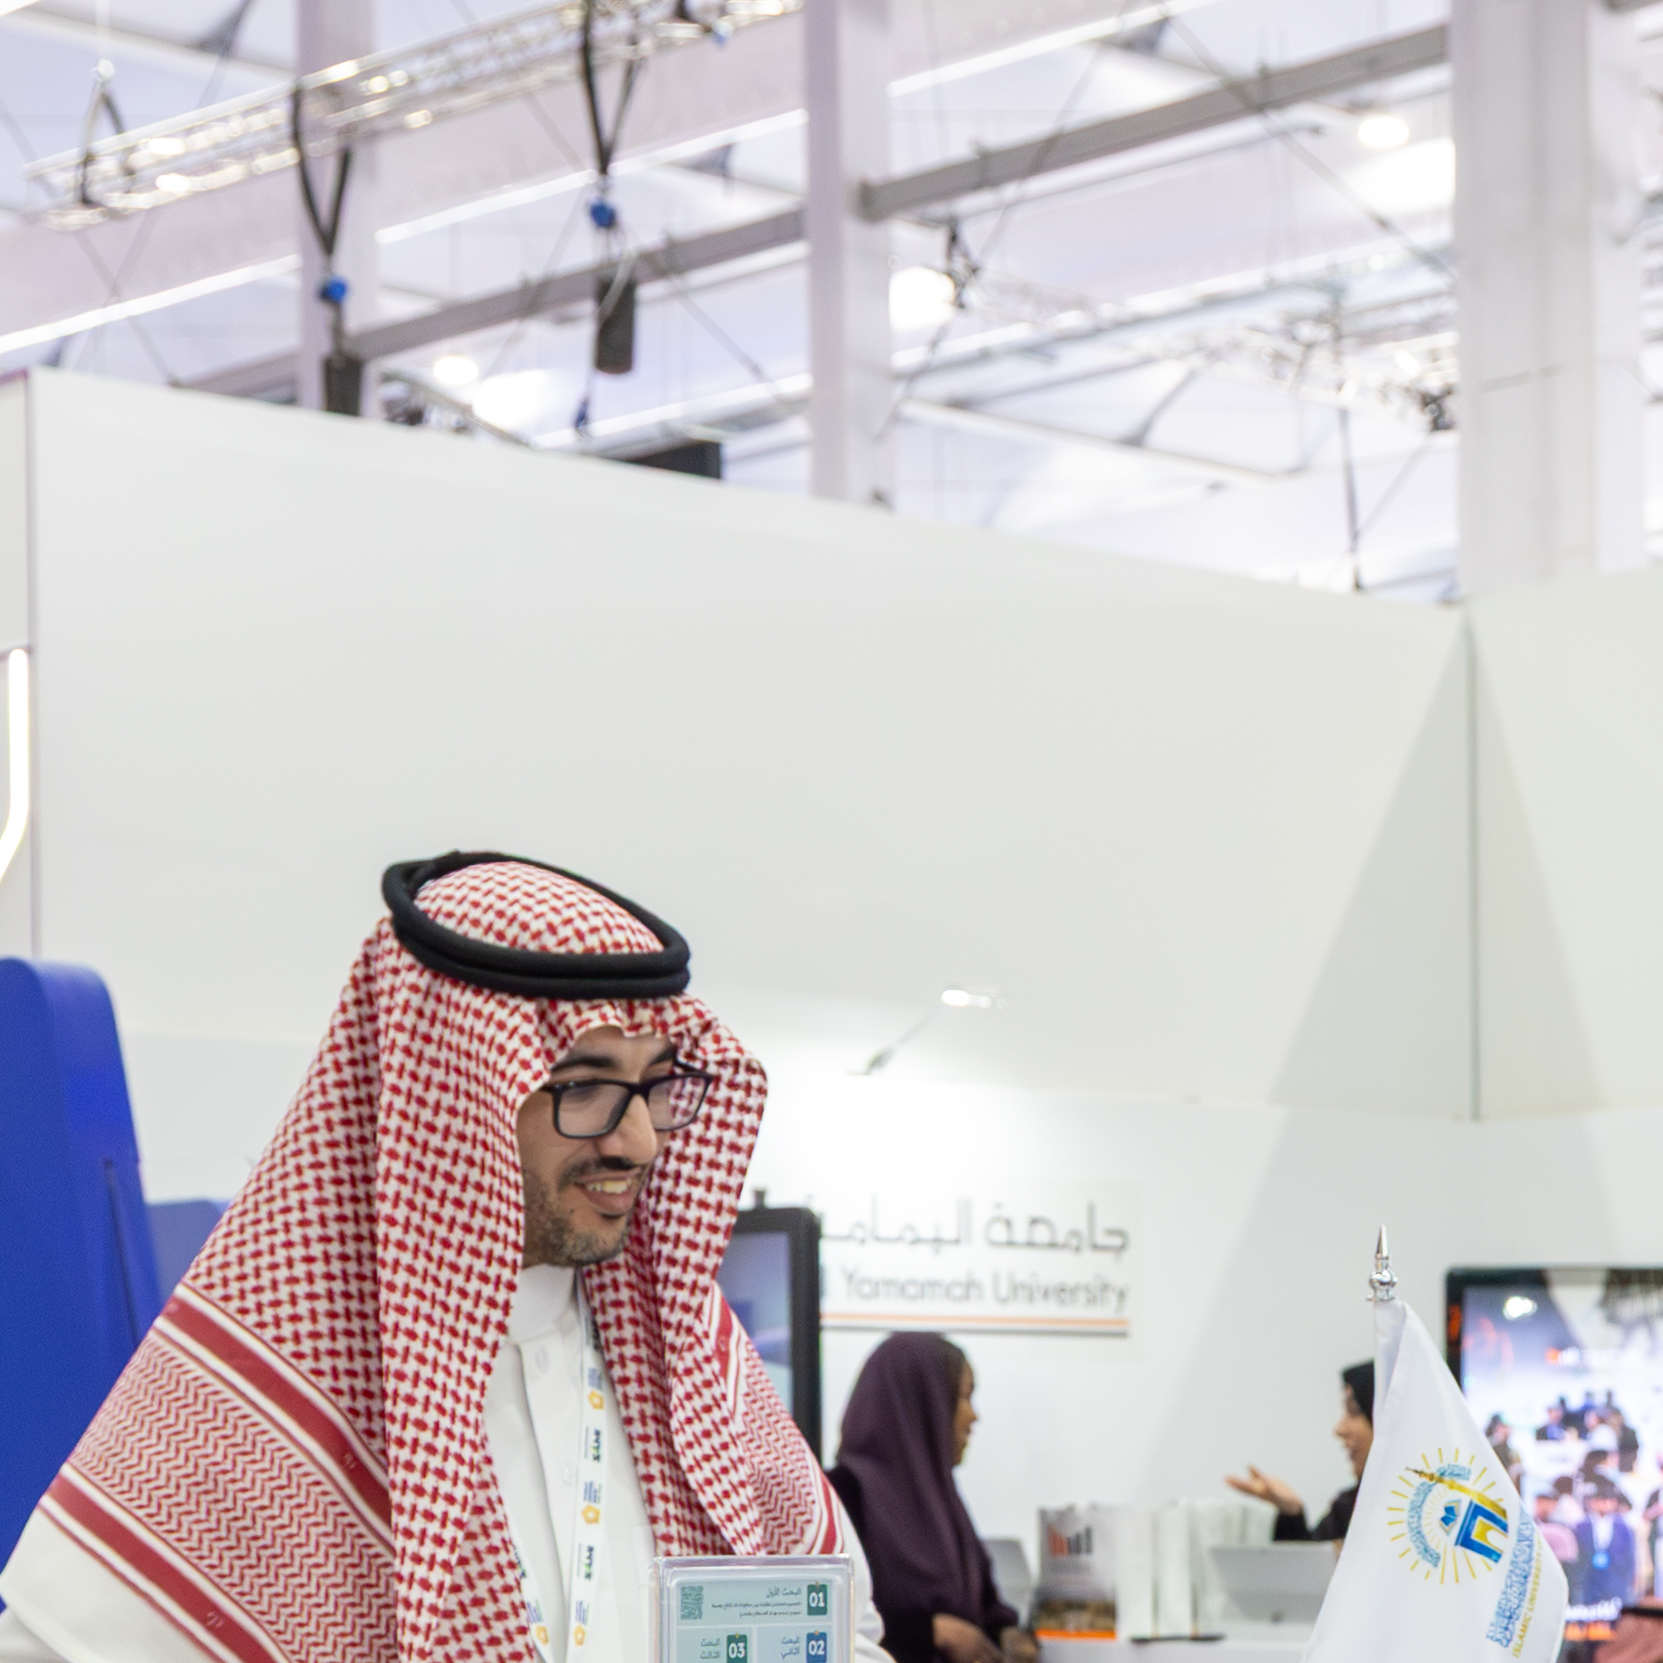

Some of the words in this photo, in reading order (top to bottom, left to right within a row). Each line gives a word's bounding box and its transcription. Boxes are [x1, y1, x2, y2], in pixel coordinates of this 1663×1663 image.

[985, 1197, 1131, 1260] جامعة
[991, 1268, 1130, 1314] University
[808, 1592, 825, 1608] 01
[728, 1643, 745, 1658] 03
[808, 1640, 825, 1656] 02
